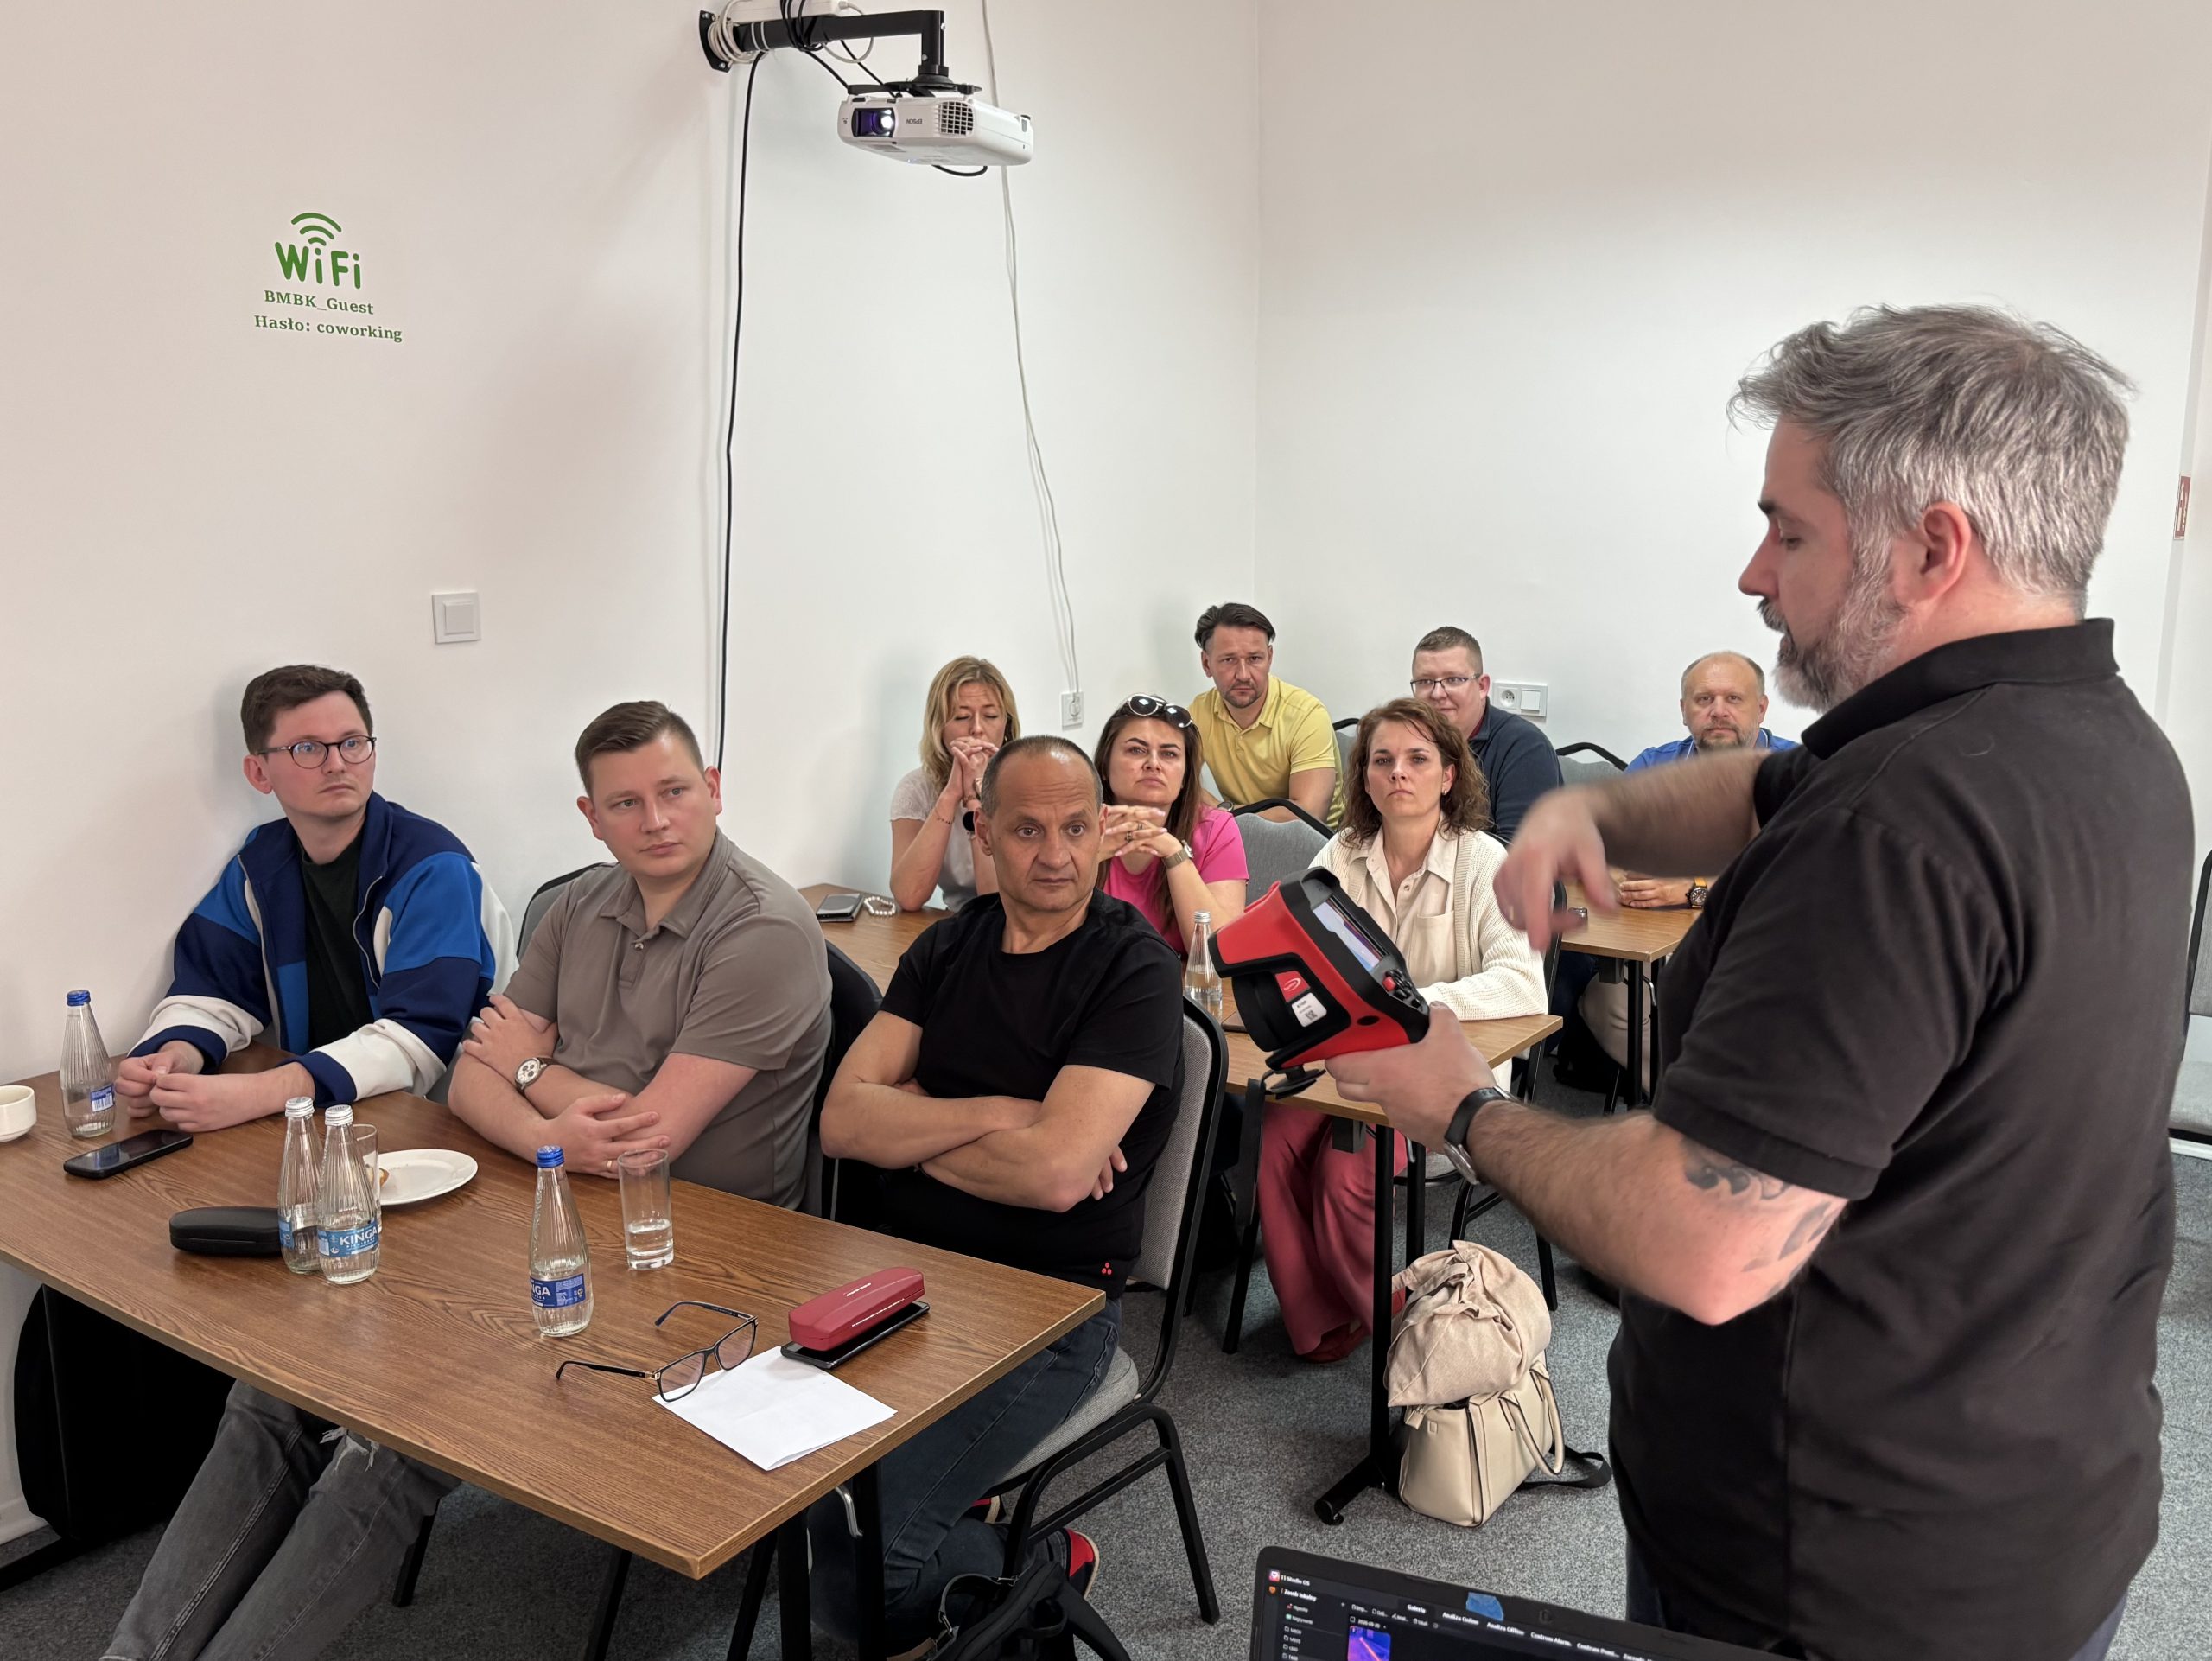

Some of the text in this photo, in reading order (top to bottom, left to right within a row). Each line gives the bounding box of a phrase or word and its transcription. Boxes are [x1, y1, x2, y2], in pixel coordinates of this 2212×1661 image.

[275, 242, 361, 290] WiFi
[264, 290, 374, 315] BMBK_Guest
[254, 315, 403, 343] Hasło: coworking
[340, 1226, 378, 1245] KINGA
